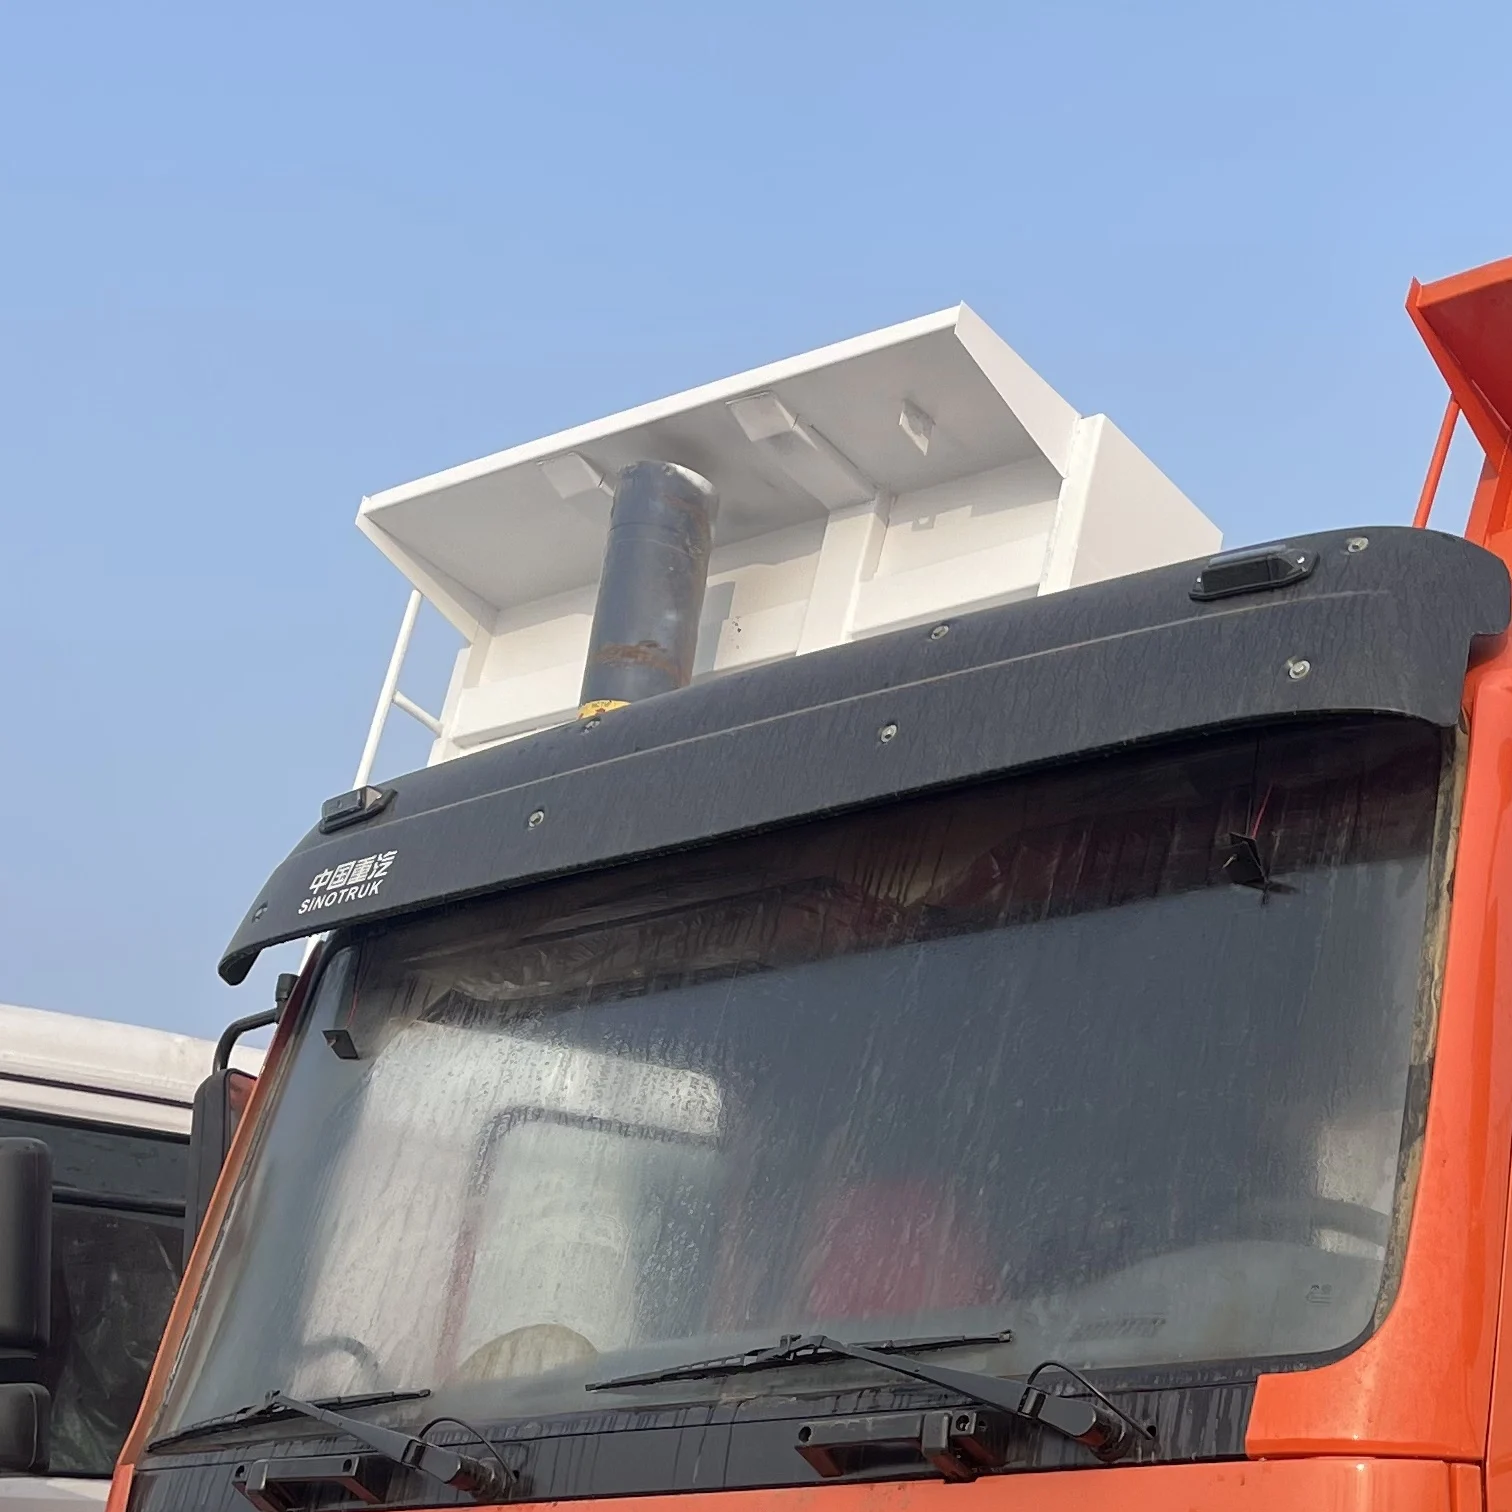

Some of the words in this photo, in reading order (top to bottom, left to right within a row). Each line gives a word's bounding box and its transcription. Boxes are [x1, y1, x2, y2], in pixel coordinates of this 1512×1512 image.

[309, 850, 398, 894] 中国重汽
[298, 879, 383, 914] SINOTRUK
